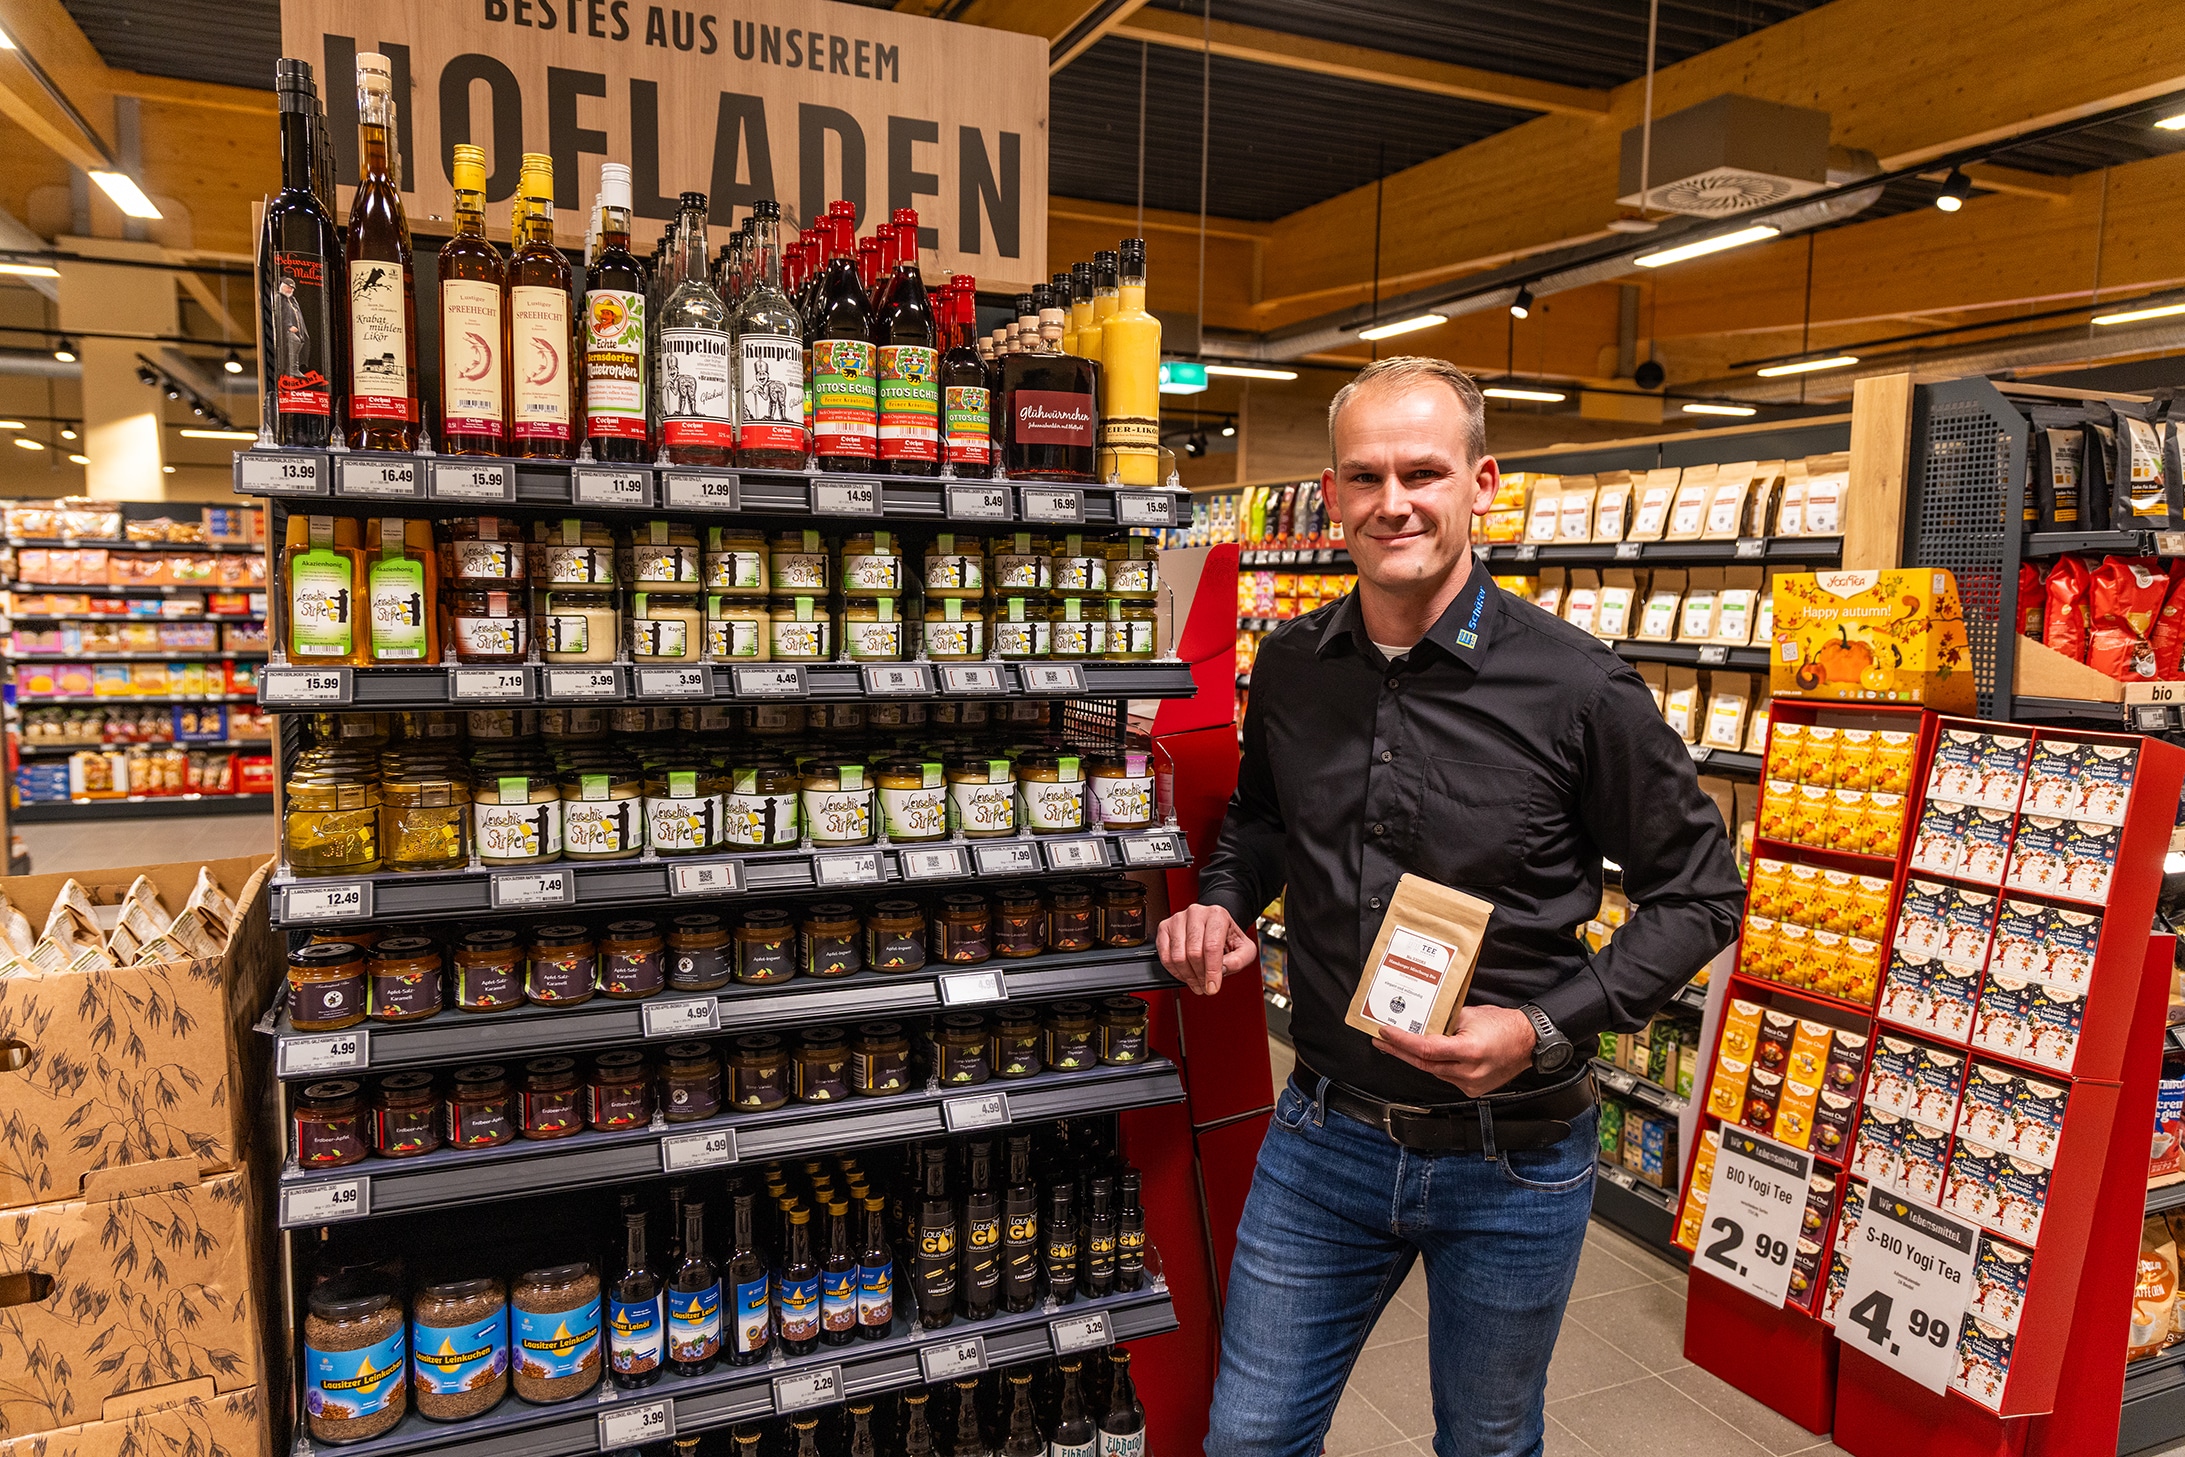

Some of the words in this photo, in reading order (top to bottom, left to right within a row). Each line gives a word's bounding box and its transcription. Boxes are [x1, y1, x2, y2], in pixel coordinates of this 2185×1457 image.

[484, 0, 629, 41] BESTES
[646, 6, 717, 55] AUS
[733, 20, 900, 83] UNSEREM
[323, 33, 1021, 258] HOFLADEN
[274, 252, 324, 269] Schwarzer
[284, 267, 324, 281] Müller
[448, 305, 497, 317] SPREEHECHT
[516, 312, 563, 322] SPREEHECHT
[356, 314, 386, 325] Krabat
[369, 322, 402, 334] mühlen
[363, 331, 389, 342] Likör
[597, 339, 617, 349] Echte
[816, 382, 847, 393] OTTO'S
[881, 388, 910, 398] OTTO'S
[913, 389, 938, 400] ECHTE
[973, 415, 990, 423] ECHTE
[1019, 405, 1090, 421] Glühwürmchen
[1107, 426, 1158, 435] EIER-LIK
[282, 465, 315, 478] 13.99
[381, 469, 412, 482] 16.49
[472, 473, 502, 486] 15.99
[613, 479, 641, 492] 11.99
[702, 483, 729, 496] 12.99
[847, 490, 872, 502] 14.99
[984, 496, 1003, 507] 8.49
[1053, 498, 1075, 509] 16.99
[1146, 502, 1168, 513] 15.99
[302, 560, 342, 569] Akazienhonig
[1803, 606, 1838, 620] Happy
[1842, 606, 1892, 618] autumn!
[306, 678, 338, 689] 15.99
[499, 676, 522, 686] 7.19
[590, 675, 613, 686] 3.99
[680, 674, 701, 684] 3.99
[776, 674, 797, 684] 4.49
[1773, 689, 1802, 697] yogitea.com
[2152, 686, 2172, 701] bio
[1151, 842, 1172, 851] 14.29
[1011, 851, 1030, 860] 7.99
[855, 861, 875, 871] 7.49
[539, 880, 562, 890] 7.49
[327, 892, 359, 905] 12.49
[1422, 944, 1438, 955] TEE
[978, 979, 995, 990] 4.99
[687, 1007, 708, 1019] 4.99
[330, 1043, 355, 1055] 4.99
[982, 1102, 1000, 1114] 4.99
[705, 1139, 726, 1152] 4.99
[1730, 1136, 1743, 1149] Wir
[1755, 1146, 1799, 1171] Lebensmittel.
[1726, 1166, 1746, 1185] BIO
[1748, 1174, 1771, 1197] Yogi
[1774, 1184, 1793, 1205] Tee
[332, 1189, 357, 1203] 4.99
[1879, 1196, 1893, 1212] Wir
[1909, 1216, 1962, 1245] Lebensmittel.
[1704, 1217, 1789, 1277] 2.99
[1866, 1227, 1902, 1255] S-BIO
[1905, 1241, 1934, 1271] Yogi
[1935, 1258, 1961, 1284] Tea
[672, 1310, 700, 1319] Lausitzer
[628, 1321, 650, 1331] Leinöl
[1086, 1322, 1103, 1334] 3.29
[1849, 1289, 1951, 1357] 4.99
[523, 1339, 558, 1350] Lausitzer
[559, 1326, 598, 1347] Leinkuchen
[415, 1350, 443, 1364] Lausitzer
[444, 1347, 491, 1364] Leinkuchen
[958, 1348, 977, 1361] 6.49
[323, 1378, 362, 1389] Lausitzer
[363, 1358, 403, 1384] Leinkuchen
[813, 1378, 833, 1391] 2.29
[643, 1411, 664, 1427] 3.99
